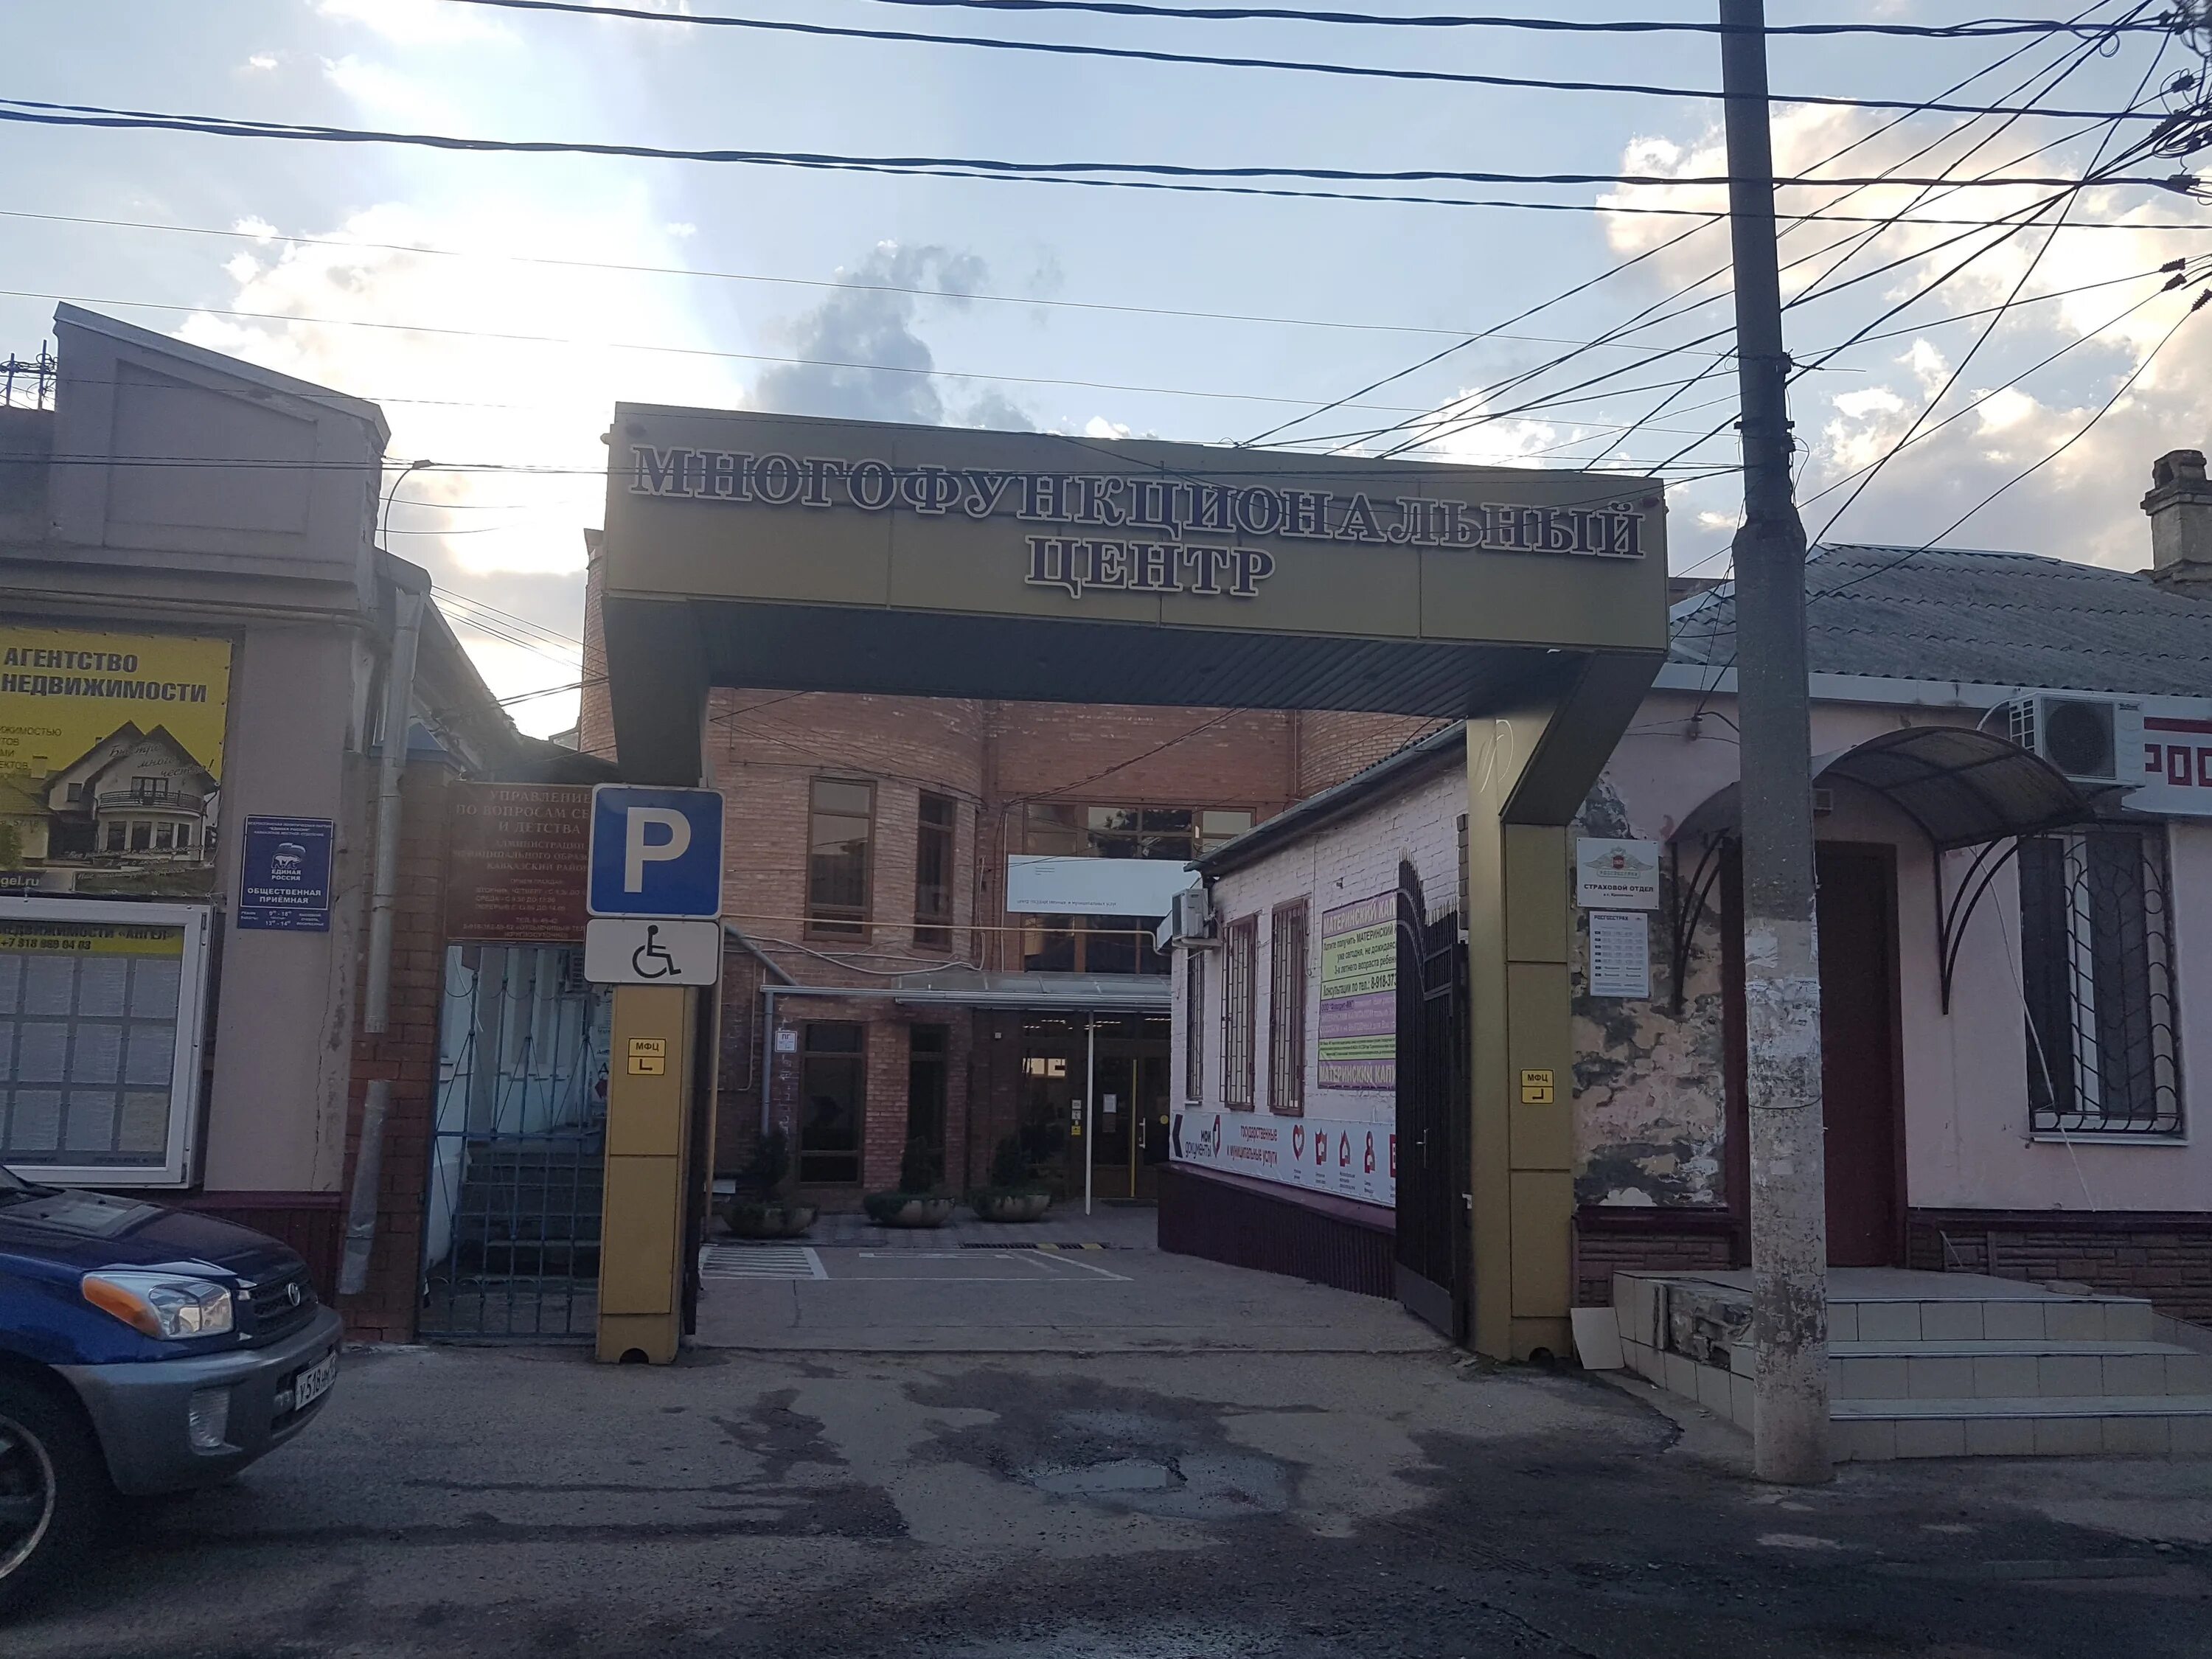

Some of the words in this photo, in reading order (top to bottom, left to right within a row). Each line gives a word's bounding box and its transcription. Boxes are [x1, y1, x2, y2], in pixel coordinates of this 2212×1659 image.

[629, 444, 1645, 559] МНОГОФУНКЦИОНАЛЬНЫЙ
[1025, 535, 1275, 598] ЦЕНТР
[4, 647, 138, 672] АГЕНТСТВО
[1, 673, 207, 702] НЕДВИЖИМОСТИ
[456, 804, 476, 815] ПО
[484, 805, 566, 818] ВОПРОСАМ
[498, 821, 509, 832] И
[516, 822, 581, 835] ДЕТСТВА
[247, 888, 321, 897] ОБЩЕСТВЕННАЯ
[260, 894, 309, 904] ПРИЁМНАЯ
[1324, 899, 1377, 935] МАТЕРИНСКИЙ
[1357, 923, 1394, 943] МАТЕРИНСКИЙ
[1352, 983, 1358, 992] по
[636, 1042, 659, 1052] МФЦ
[1528, 1074, 1548, 1082] МФЦ
[1240, 1124, 1278, 1144] государственные
[1262, 1150, 1278, 1168] услуги
